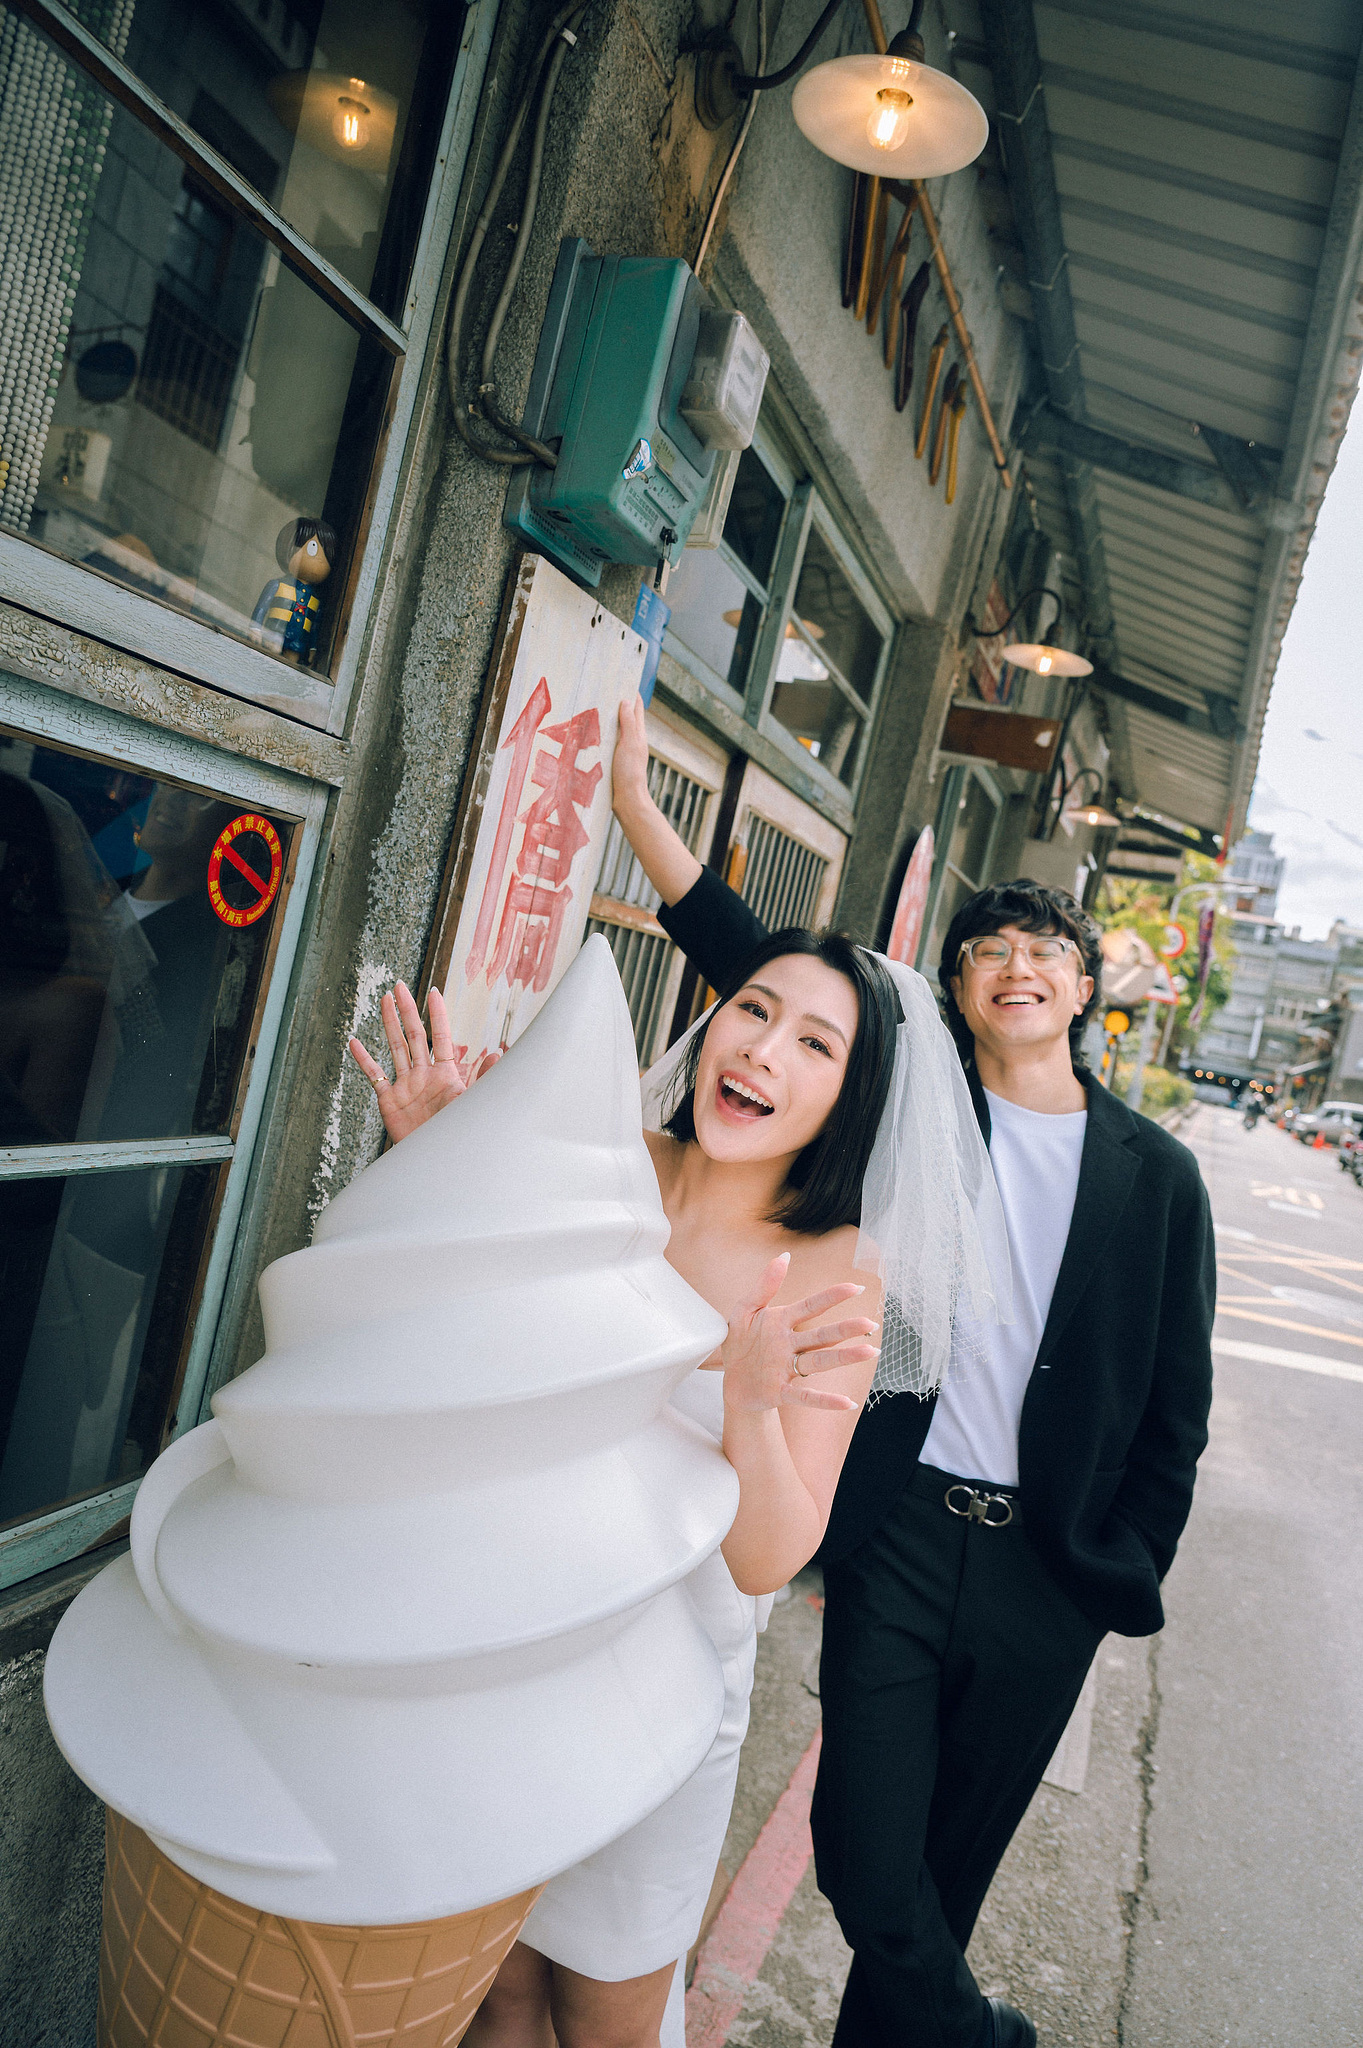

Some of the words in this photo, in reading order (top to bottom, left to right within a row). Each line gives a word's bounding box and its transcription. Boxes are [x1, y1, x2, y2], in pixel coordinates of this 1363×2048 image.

[213, 816, 280, 861] 本場所禁止吸菸
[453, 677, 603, 1078] 僑
